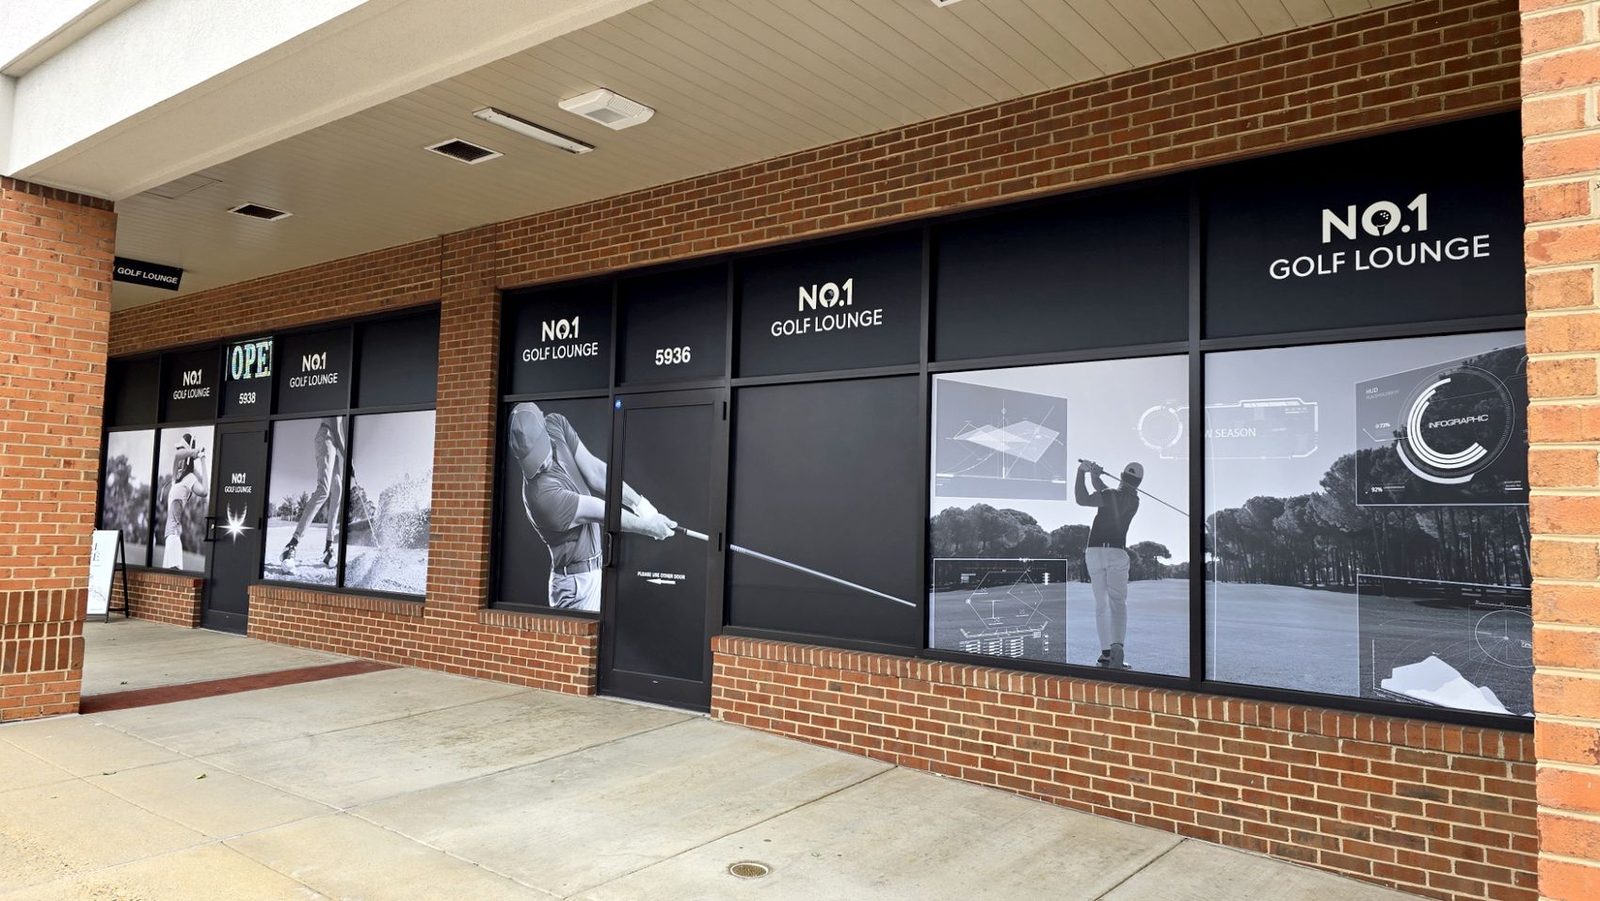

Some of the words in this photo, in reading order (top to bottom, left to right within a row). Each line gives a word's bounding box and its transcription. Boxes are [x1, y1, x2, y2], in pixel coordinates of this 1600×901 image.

[1322, 193, 1428, 244] NO.1
[1269, 252, 1346, 280] GOLF
[1355, 234, 1490, 271] LOUNGE
[117, 266, 142, 277] GOLF
[142, 271, 179, 284] LOUNGE
[798, 278, 853, 312] NO.1
[541, 315, 580, 342] NO.1
[771, 317, 811, 337] GOLF
[815, 308, 883, 332] LOUNGE
[231, 340, 273, 380] OPE
[301, 351, 327, 372] NO.1
[522, 347, 551, 362] GOLF
[552, 342, 598, 360] LOUNGE
[655, 346, 691, 366] 5936
[182, 369, 203, 387] NO.1
[289, 375, 308, 388] GOLF
[308, 372, 339, 386] LOUNGE
[173, 389, 188, 400] GOLF
[188, 387, 211, 399] LOUNGE
[238, 392, 256, 405] 5938
[1428, 414, 1489, 429] INFOGRAPHIC
[1215, 427, 1257, 438] SEASON
